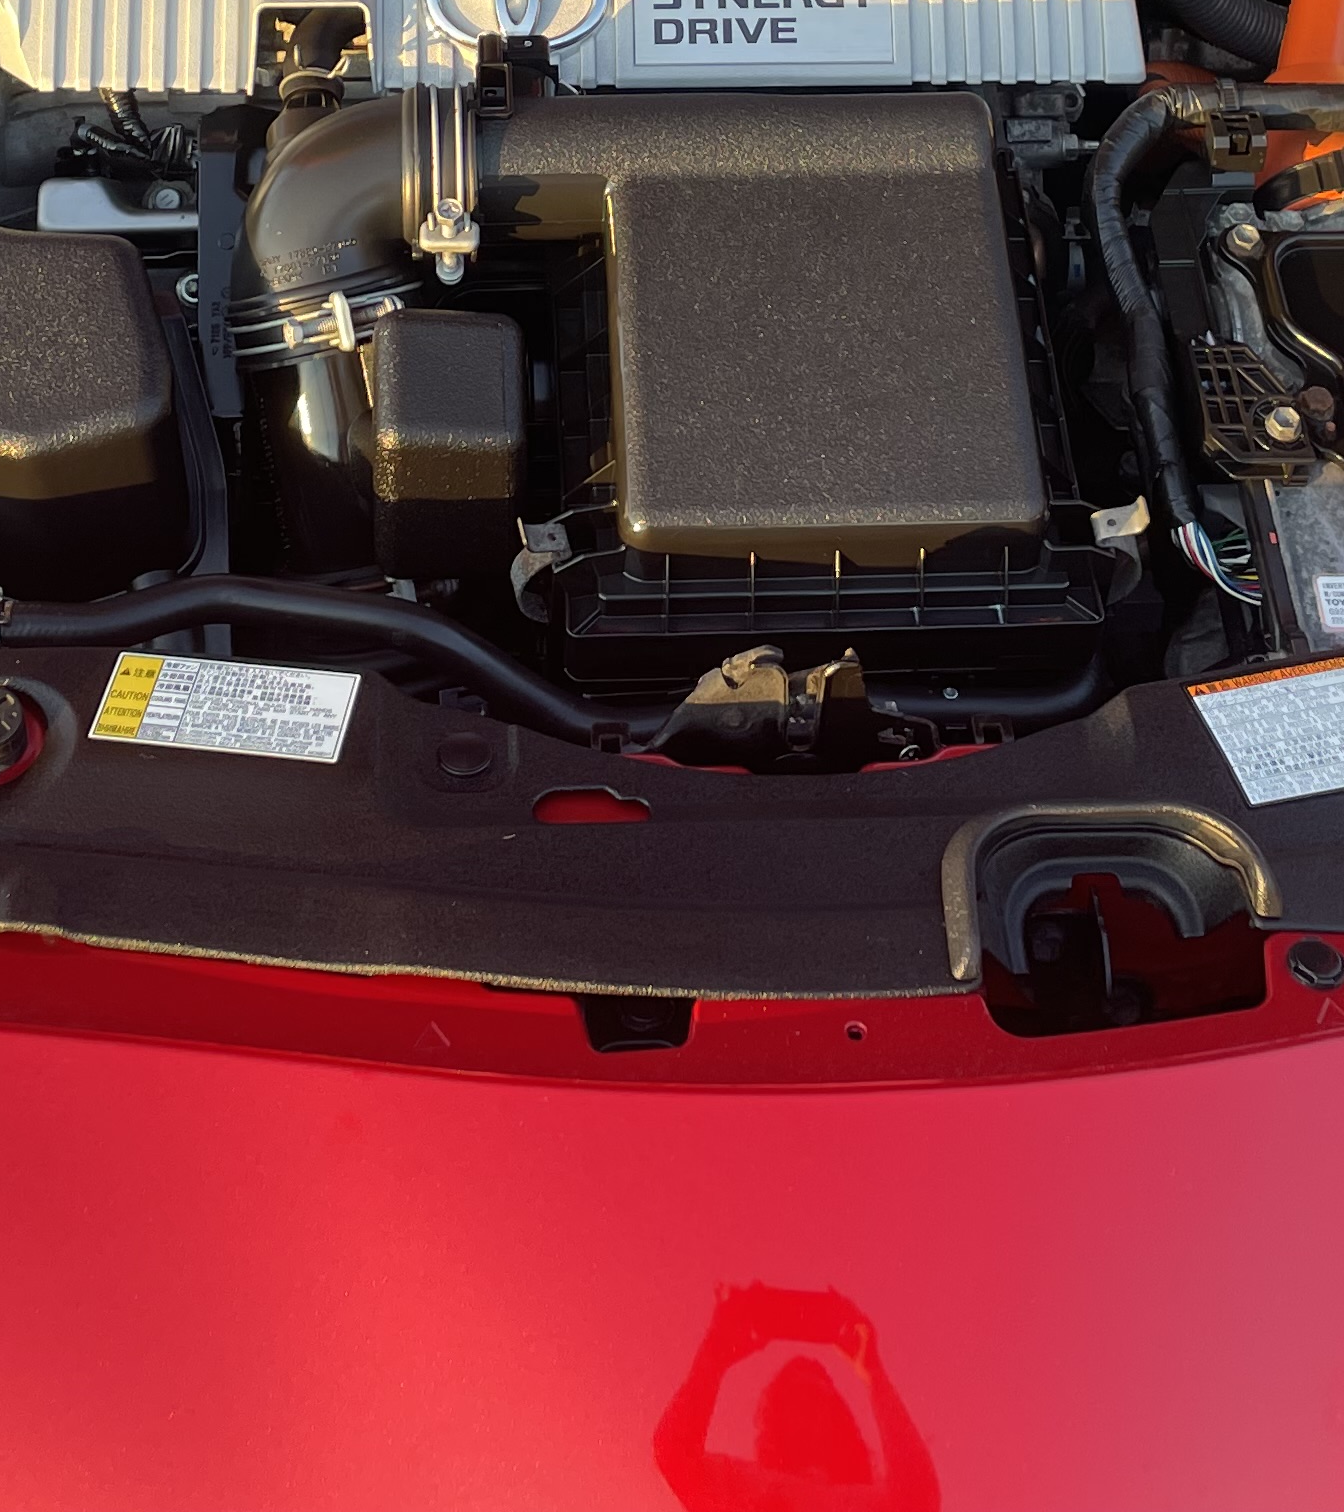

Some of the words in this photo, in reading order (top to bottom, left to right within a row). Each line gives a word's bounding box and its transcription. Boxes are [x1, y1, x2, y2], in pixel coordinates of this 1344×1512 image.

[653, 17, 798, 45] DRIVE
[110, 689, 150, 701] CAUTION
[104, 706, 143, 718] ATTENTION
